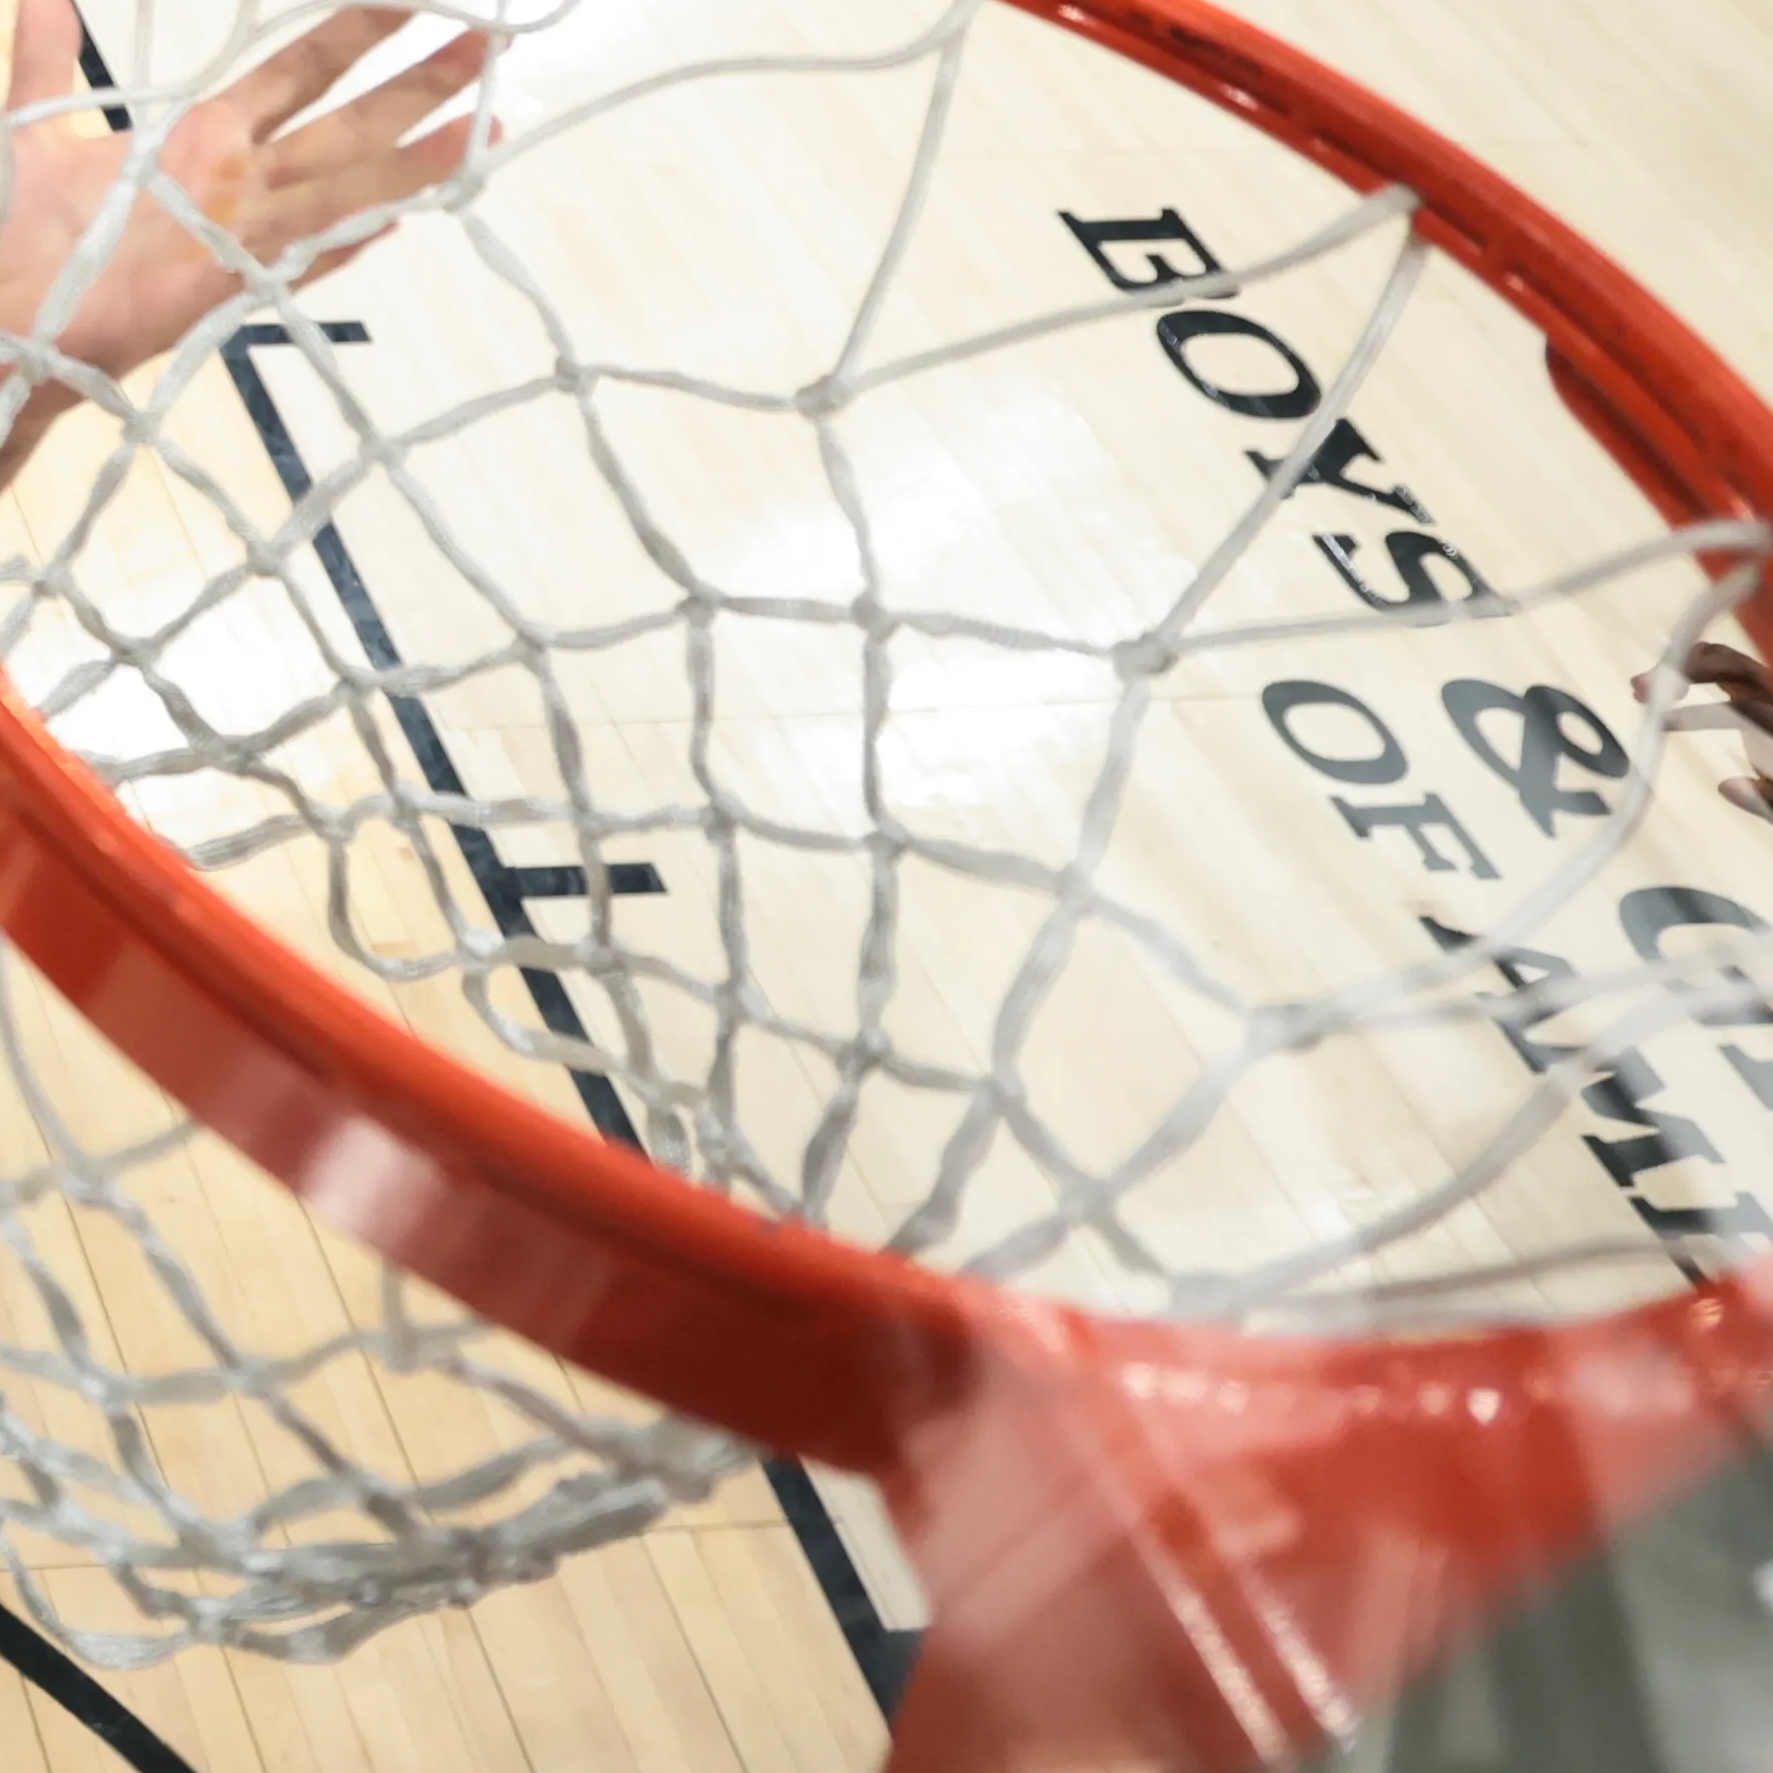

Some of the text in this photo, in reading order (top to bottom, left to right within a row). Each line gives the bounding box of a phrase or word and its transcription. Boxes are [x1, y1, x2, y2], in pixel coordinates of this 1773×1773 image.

[1057, 206, 1630, 839] BOYS &
[1261, 678, 1504, 880] OF
